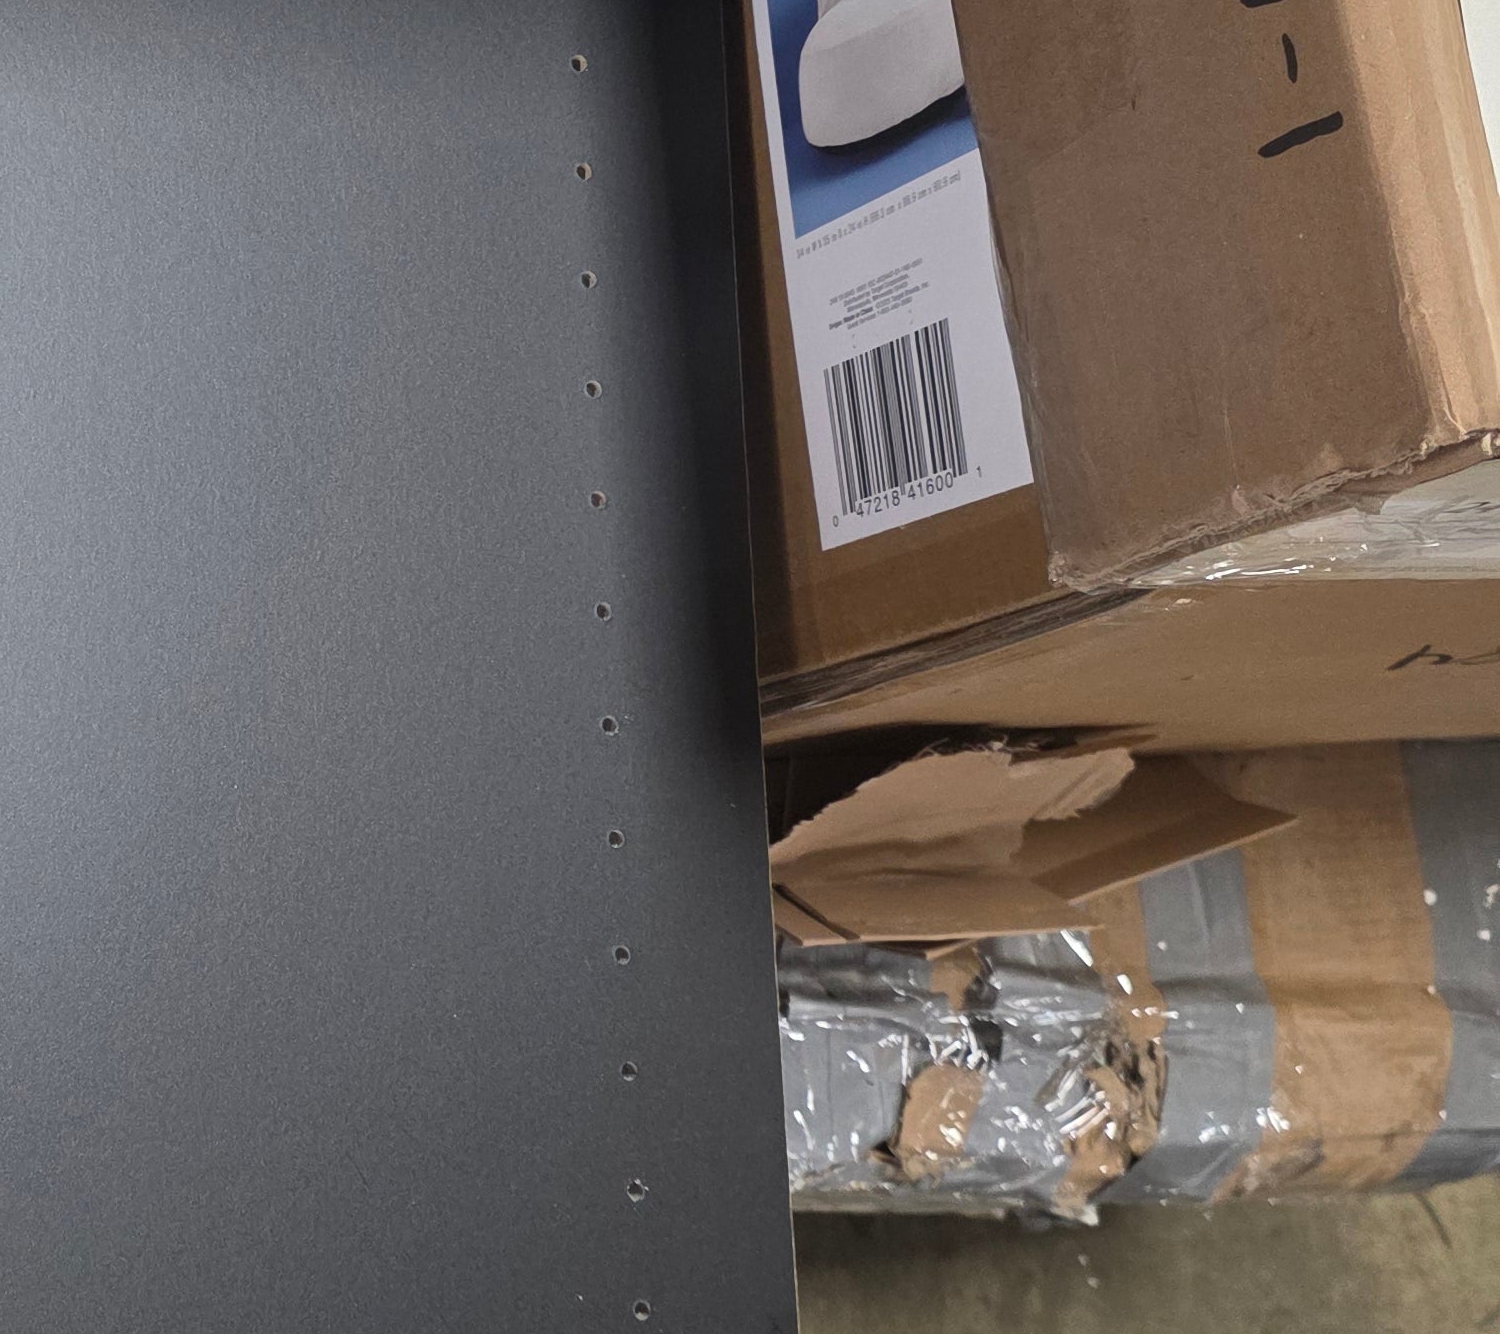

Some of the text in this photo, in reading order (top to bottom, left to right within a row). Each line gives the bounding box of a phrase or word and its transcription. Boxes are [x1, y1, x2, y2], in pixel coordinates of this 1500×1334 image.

[831, 514, 840, 528] 0
[855, 489, 901, 518] 47218
[907, 471, 954, 501] 41600
